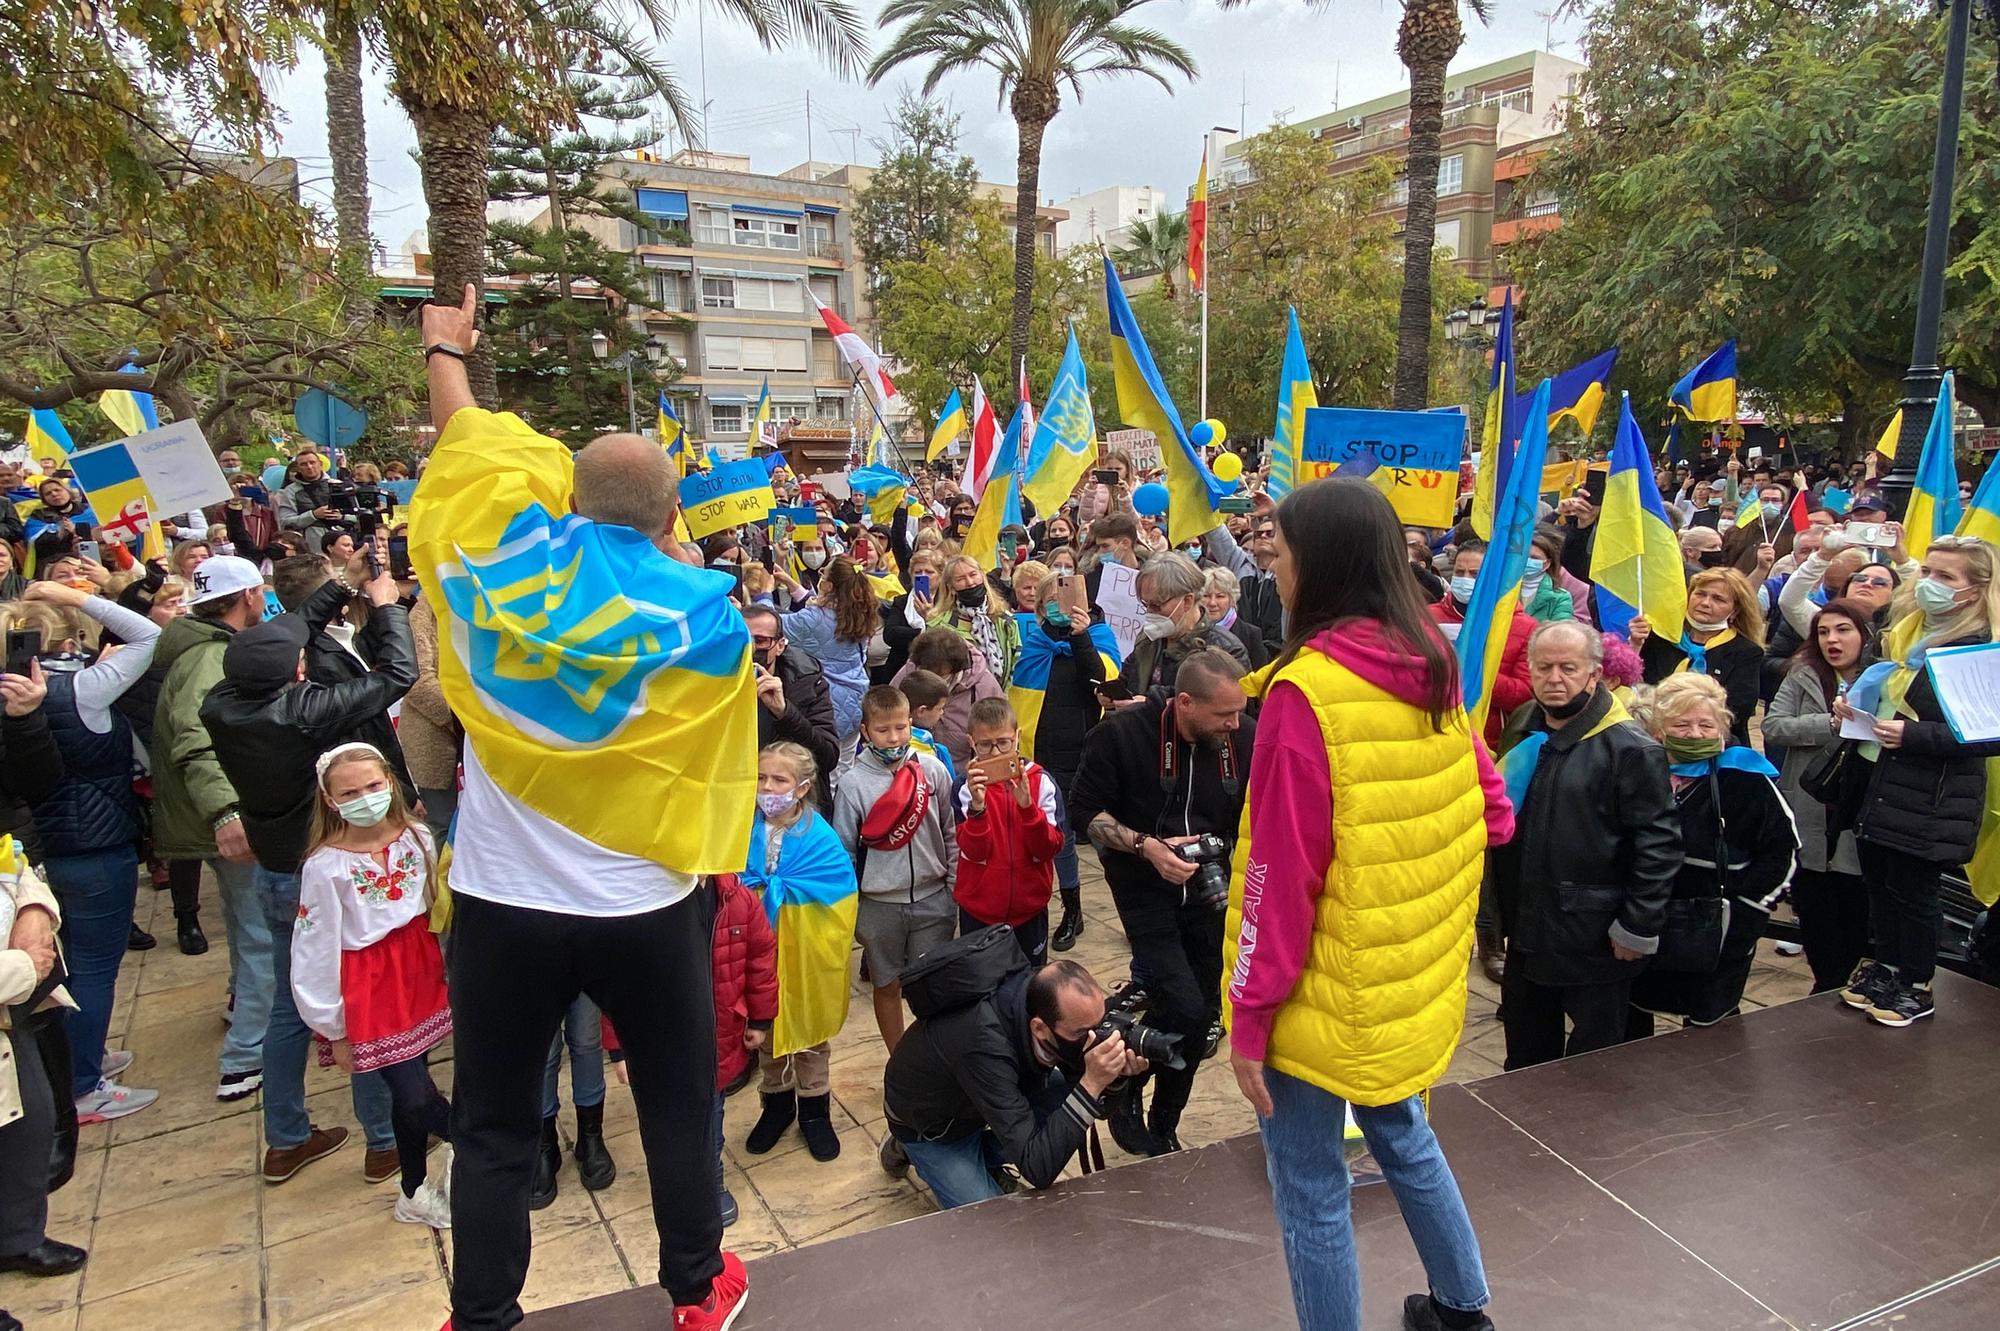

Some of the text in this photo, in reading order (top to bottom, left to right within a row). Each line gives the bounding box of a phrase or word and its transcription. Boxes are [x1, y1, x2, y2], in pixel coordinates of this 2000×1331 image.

[1133, 438, 1160, 450] MATA
[1341, 440, 1420, 466] STOP
[695, 473, 755, 498] STOP PUTIN
[699, 496, 761, 522] STOP WAR
[193, 571, 212, 594] NY
[1165, 741, 1173, 769] Canon
[914, 782, 927, 815] MOVE
[1229, 856, 1268, 999] NIKE AIR
